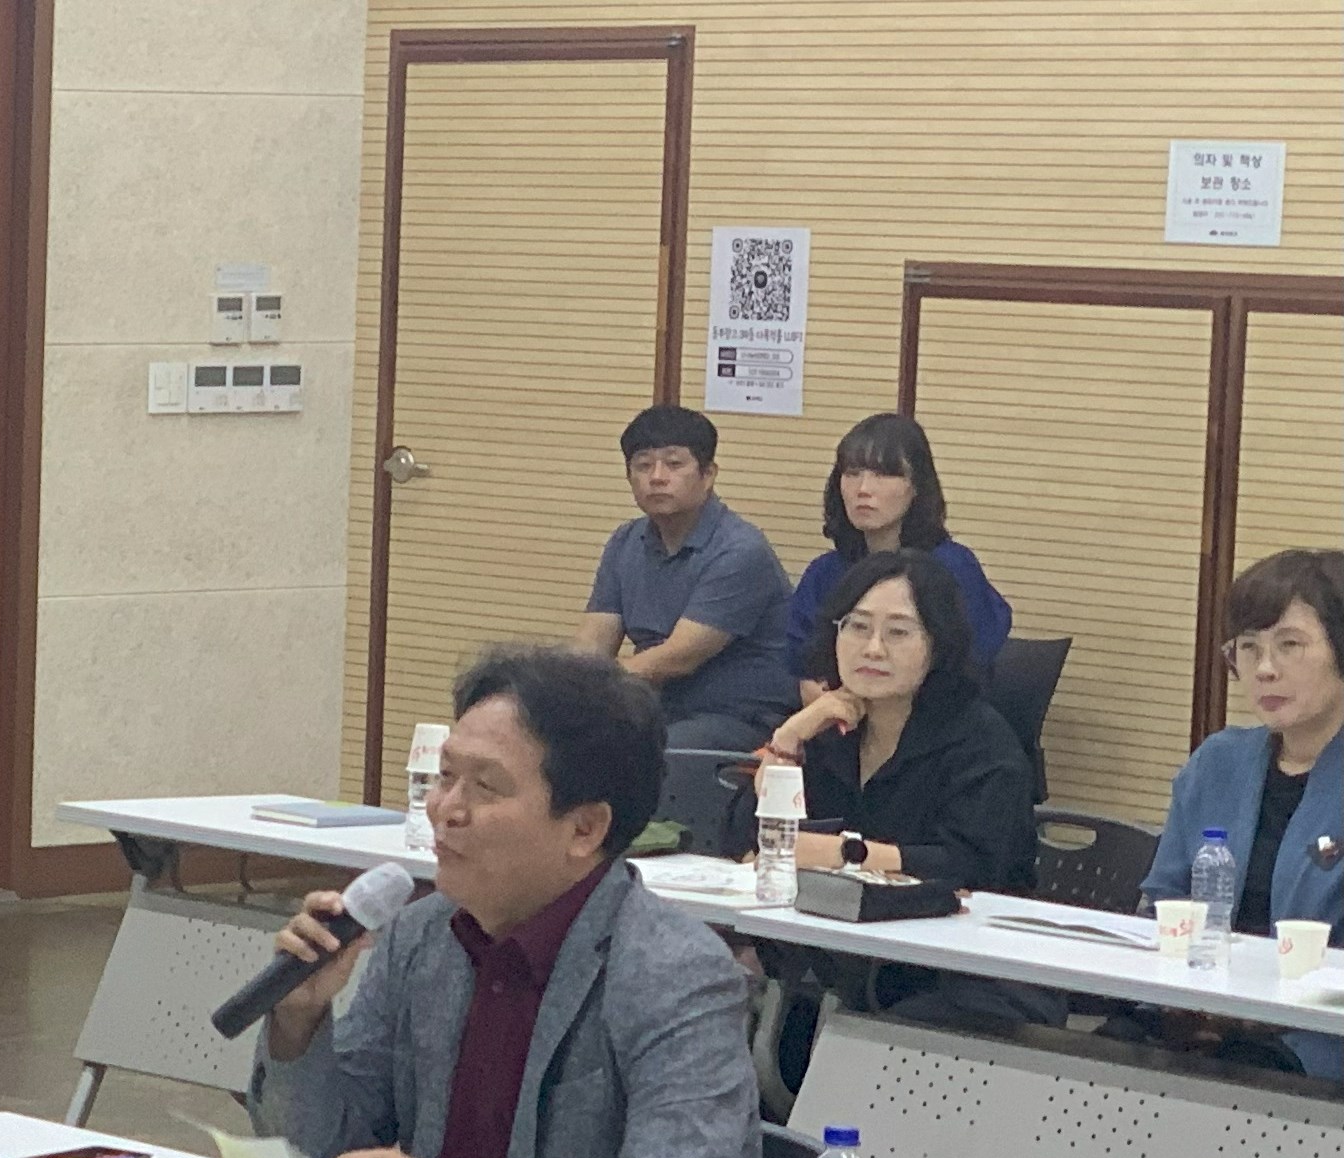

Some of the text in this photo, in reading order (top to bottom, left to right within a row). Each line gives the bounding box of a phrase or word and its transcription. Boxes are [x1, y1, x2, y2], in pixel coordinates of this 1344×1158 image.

[1193, 152, 1263, 169] 의자 및 책상
[1200, 175, 1252, 191] 보관 장소
